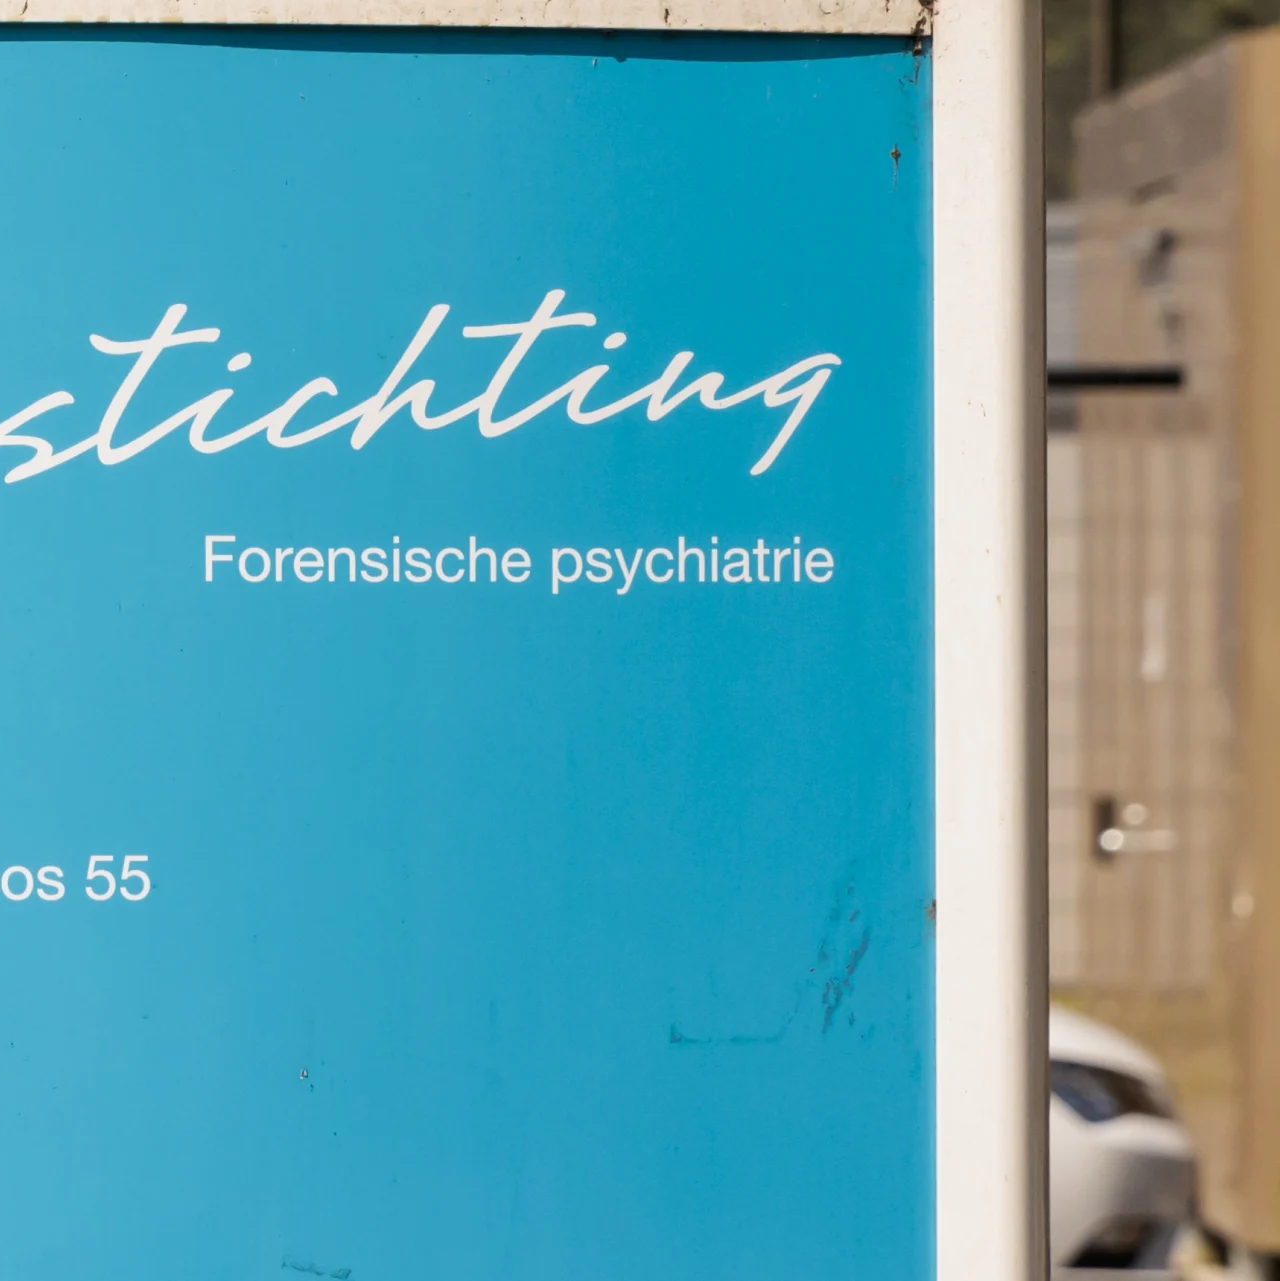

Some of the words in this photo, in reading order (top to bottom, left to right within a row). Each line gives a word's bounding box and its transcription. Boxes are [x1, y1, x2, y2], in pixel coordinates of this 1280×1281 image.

[205, 535, 532, 585] Forensische
[551, 535, 834, 595] psychiatrie
[85, 854, 152, 901] 55
